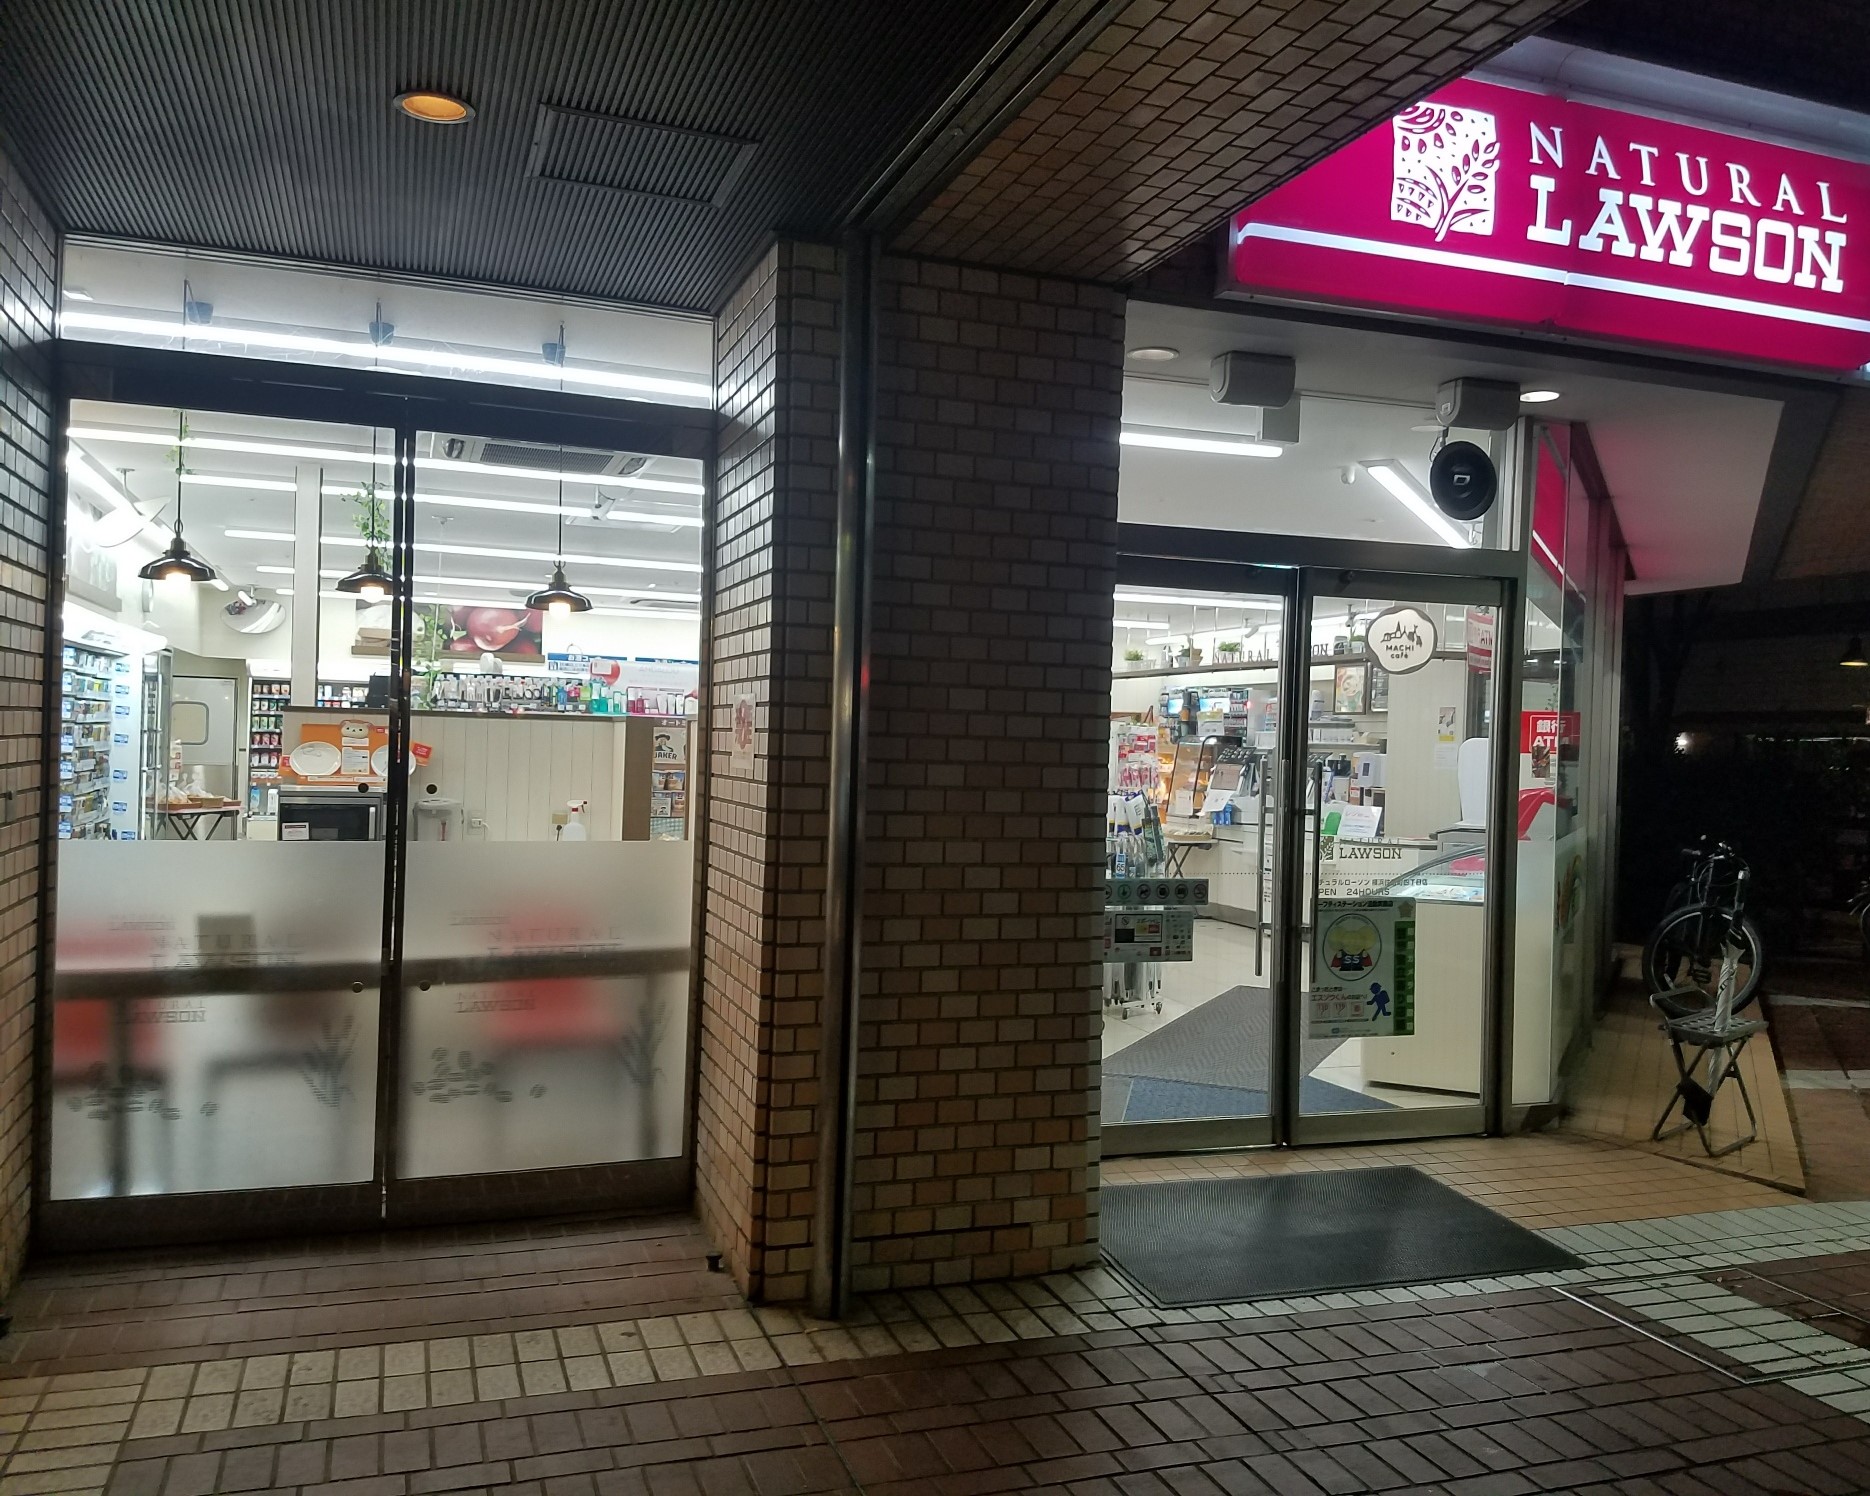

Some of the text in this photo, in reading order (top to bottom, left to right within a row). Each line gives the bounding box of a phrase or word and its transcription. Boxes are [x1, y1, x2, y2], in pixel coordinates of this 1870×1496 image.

[1528, 121, 1849, 225] NATURAL
[1526, 175, 1848, 295] LAWSON
[1385, 644, 1415, 652] MACHI
[1339, 847, 1403, 860] LAWSON
[1116, 863, 1125, 872] 65
[1317, 878, 1370, 887] チュラルローソン
[1317, 888, 1337, 896] PEN
[1343, 955, 1360, 964] SS
